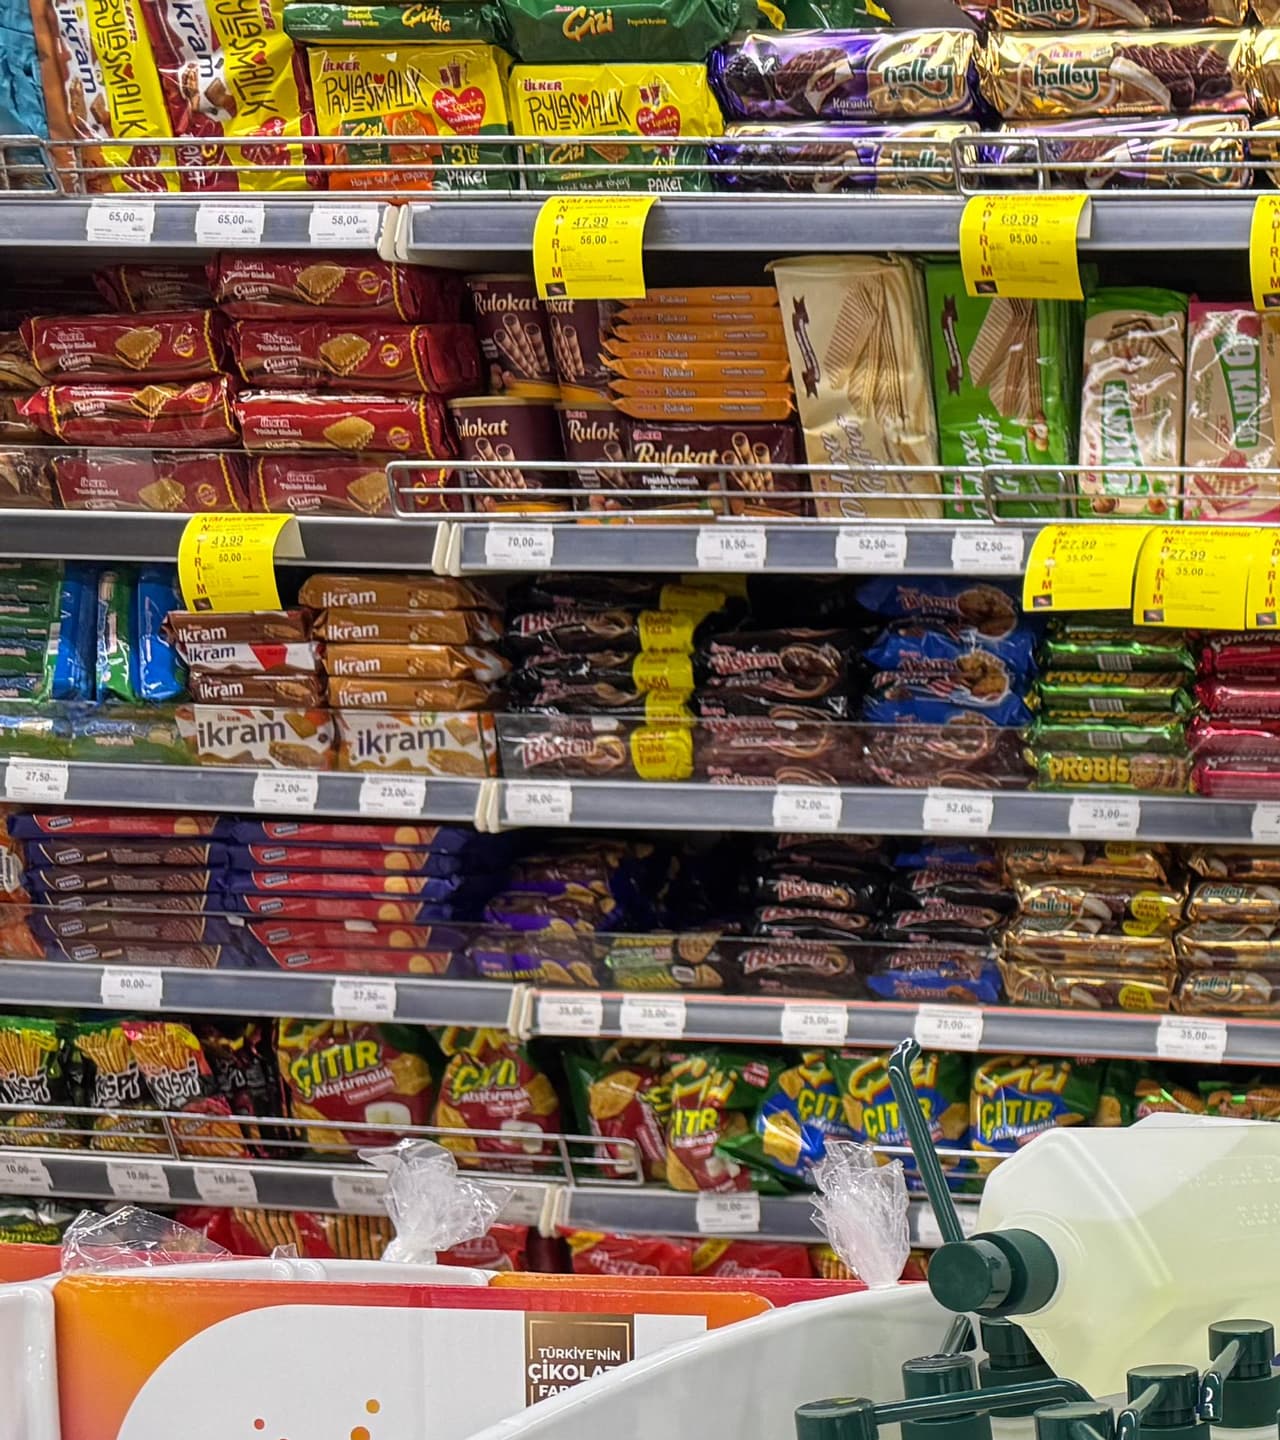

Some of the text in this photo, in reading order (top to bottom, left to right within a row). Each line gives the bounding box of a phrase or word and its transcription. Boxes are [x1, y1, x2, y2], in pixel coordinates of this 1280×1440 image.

[562, 5, 615, 43] Çizi
[58, 9, 95, 94] ikram
[523, 78, 563, 92] ÜLKER
[884, 58, 954, 99] halley
[1033, 63, 1099, 101] halley
[108, 212, 136, 223] 65,00
[217, 214, 245, 225] 65,00
[332, 214, 359, 226] 58,00
[1009, 233, 1038, 245] 95,00
[473, 292, 538, 315] Rulokat
[567, 419, 620, 441] Rulok
[508, 536, 535, 548] 70,00
[719, 539, 747, 550] 18,50
[859, 539, 888, 551] 52,50
[975, 541, 1003, 552] 52,50
[1168, 549, 1207, 561] 27,99
[322, 590, 377, 607] ikram
[178, 626, 228, 643] ikram
[334, 657, 381, 675] ikram
[197, 718, 287, 749] ikram
[357, 725, 446, 756] ikram
[1050, 754, 1132, 784] PROBİS
[290, 1041, 381, 1098] ÇITIR
[538, 1346, 622, 1362] TÜRKİYE'NİN
